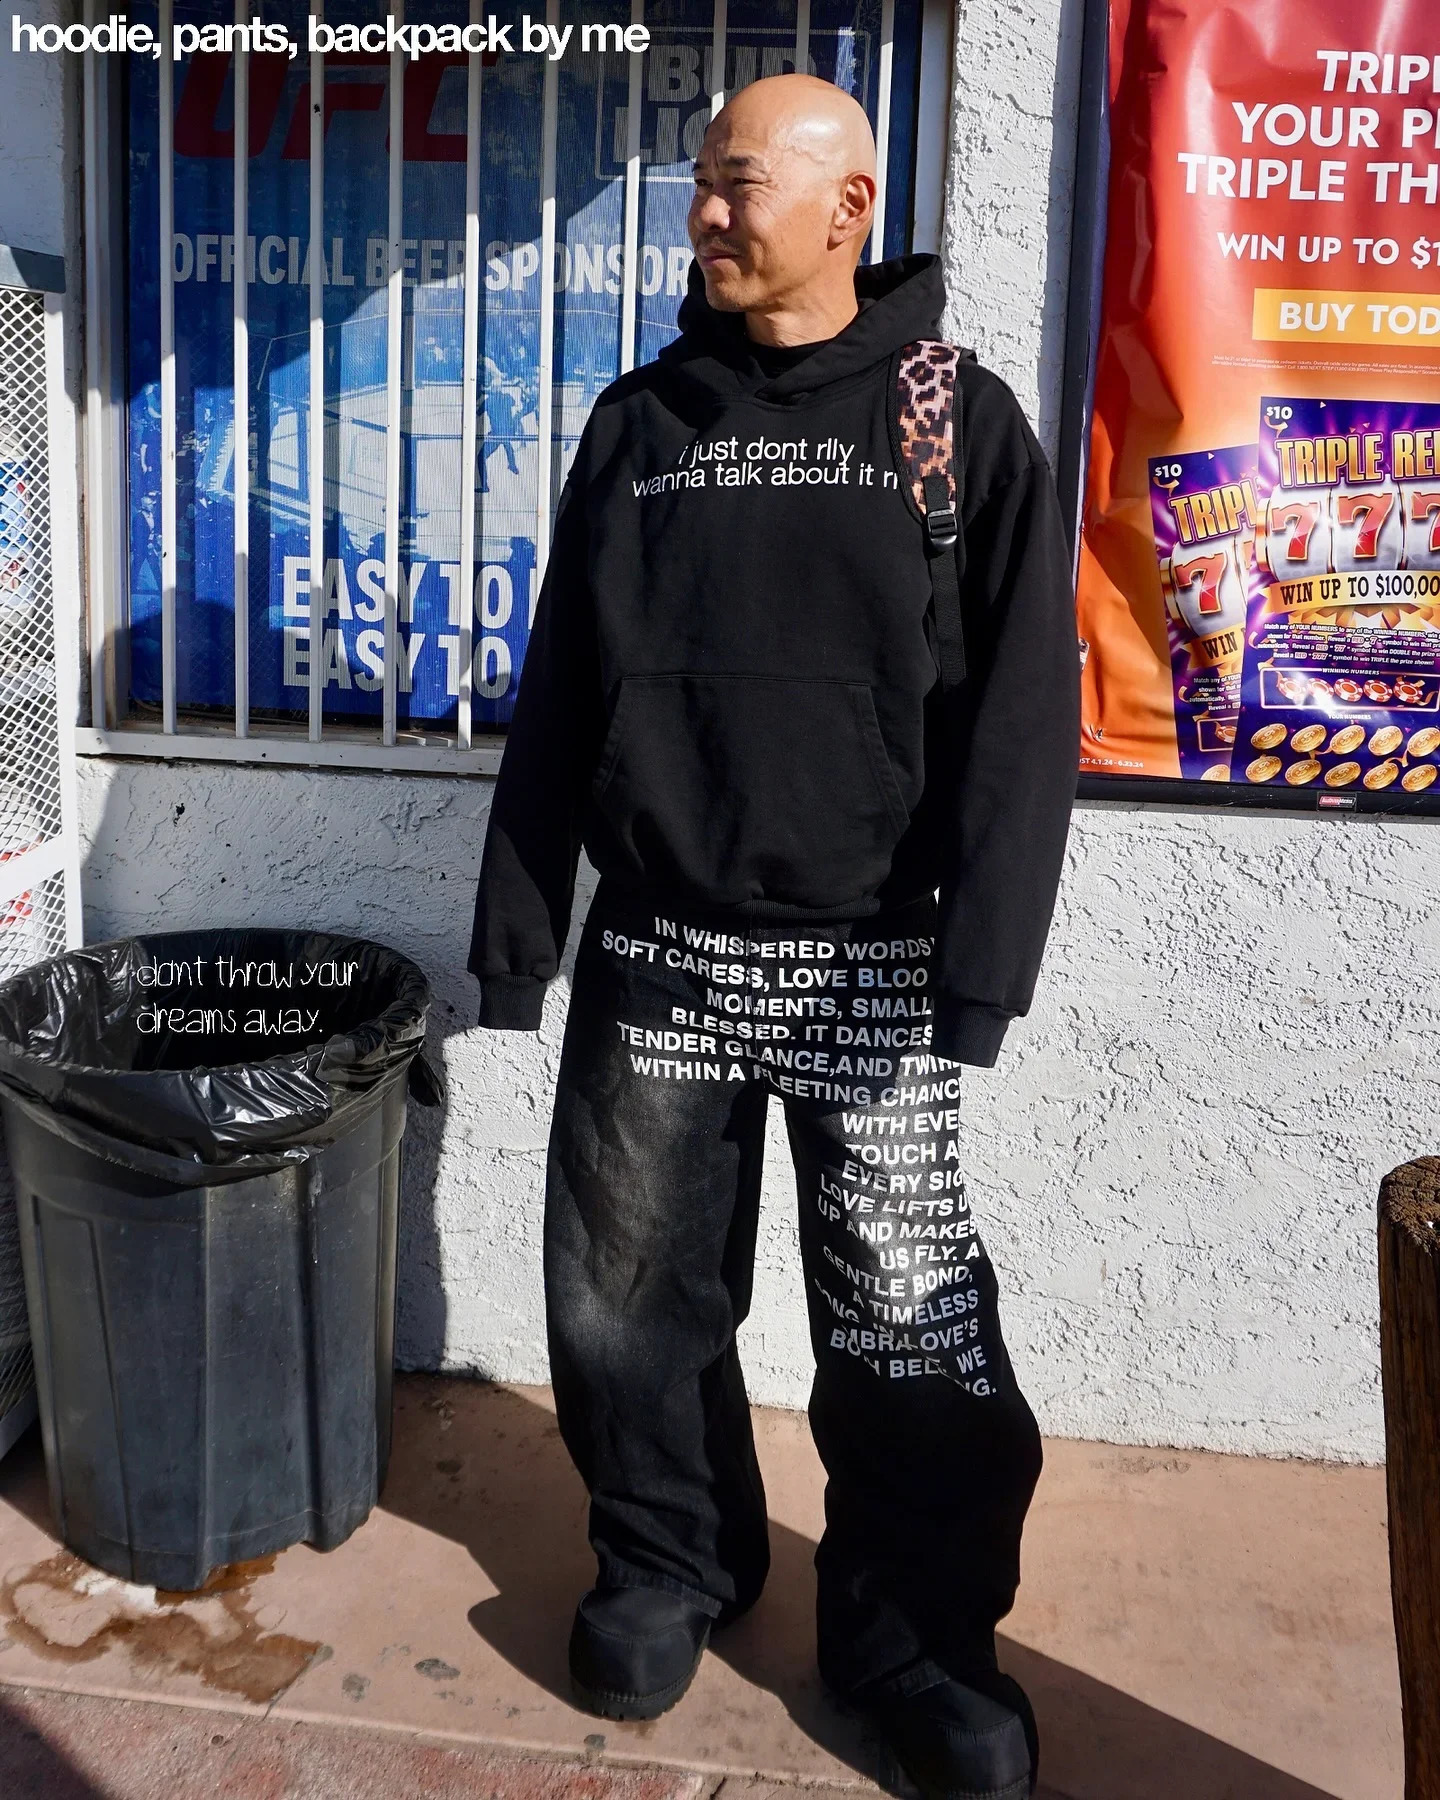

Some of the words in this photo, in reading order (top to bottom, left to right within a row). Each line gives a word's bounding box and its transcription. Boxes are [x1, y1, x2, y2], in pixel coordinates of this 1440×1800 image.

[174, 46, 500, 162] UFC
[1231, 102, 1380, 148] YOUR
[1177, 153, 1346, 202] TRIPLE
[1366, 162, 1440, 204] TH
[172, 233, 354, 287] OFFICIAL
[366, 238, 466, 289] BEER
[1217, 232, 1285, 261] WIN
[1299, 236, 1342, 263] UP
[1353, 238, 1400, 265] TO
[1410, 236, 1440, 270] $1
[1280, 302, 1355, 331] BUY
[1366, 305, 1440, 336] TOD
[1266, 406, 1293, 420] $10
[689, 437, 738, 467] just
[746, 436, 808, 460] dont
[817, 438, 854, 467] rlly
[1275, 432, 1384, 489] TRIPLE
[632, 468, 706, 497] wanna
[715, 462, 763, 487] talk
[771, 463, 849, 485] about
[858, 462, 874, 486] it
[1155, 464, 1182, 478] $10
[1272, 501, 1321, 561] 7
[1338, 492, 1396, 559] 7
[284, 556, 425, 624] EASY
[439, 563, 513, 629] TO
[1174, 551, 1227, 615] 7
[1280, 581, 1314, 606] WIN
[1320, 577, 1341, 600] UP
[1349, 576, 1370, 598] TO
[283, 627, 425, 693] EASY
[438, 635, 512, 699] TO
[1202, 631, 1238, 659] WIN
[655, 917, 677, 939] IN
[683, 926, 835, 958] WHISPERED
[602, 930, 659, 962] SOFT
[665, 948, 769, 992] CARESS,
[779, 968, 848, 988] LOVE
[858, 968, 928, 987] BLOO
[707, 987, 842, 1019] MOMENTS,
[851, 997, 931, 1018] SMALL
[617, 1020, 716, 1055] TENDER
[672, 1006, 796, 1039] BLESSED.
[805, 1025, 828, 1042] IT
[836, 1024, 932, 1047] DANCES
[630, 1054, 721, 1080] WITHIN
[727, 1063, 746, 1081] A
[842, 1112, 907, 1135] WITH
[914, 1109, 959, 1134] EVE
[845, 1142, 936, 1165] TOUCH
[944, 1140, 960, 1161] A
[820, 1173, 875, 1213] LOVE
[882, 1198, 953, 1217] LIFTS
[842, 1160, 922, 1194] EVERY
[818, 1194, 841, 1222] UP
[846, 1219, 893, 1242] AND
[900, 1215, 977, 1240] MAKES
[823, 1245, 905, 1297] GENTLE
[912, 1265, 973, 1296] BOND,
[880, 1247, 910, 1270] US
[915, 1245, 958, 1265] FLY.
[964, 1241, 980, 1260] A
[869, 1289, 979, 1326] TIMELESS
[956, 1345, 987, 1375] WE
